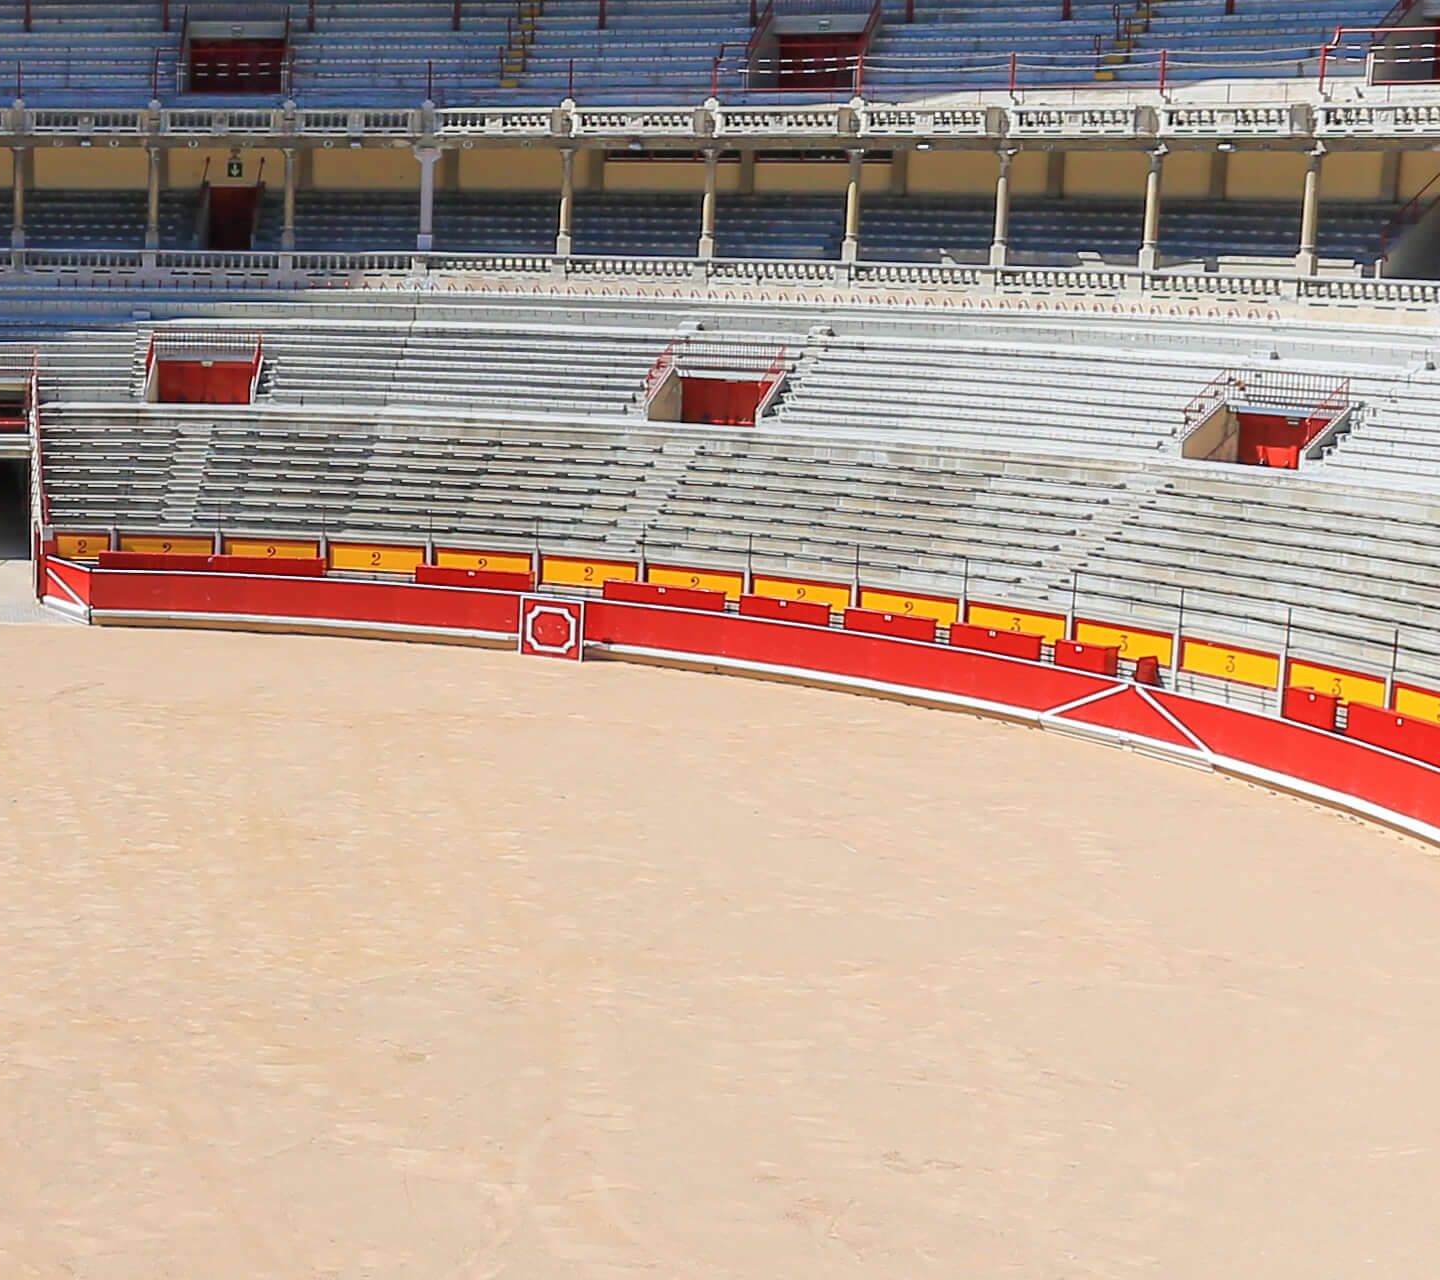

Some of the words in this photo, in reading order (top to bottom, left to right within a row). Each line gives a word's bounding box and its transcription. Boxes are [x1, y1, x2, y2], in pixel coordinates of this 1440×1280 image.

[77, 540, 87, 554] 2
[371, 552, 381, 566] 2
[583, 566, 594, 581] 2
[1010, 617, 1021, 632] 3
[1119, 634, 1129, 652] 3
[1225, 655, 1236, 673] 3
[1332, 678, 1342, 696] 3
